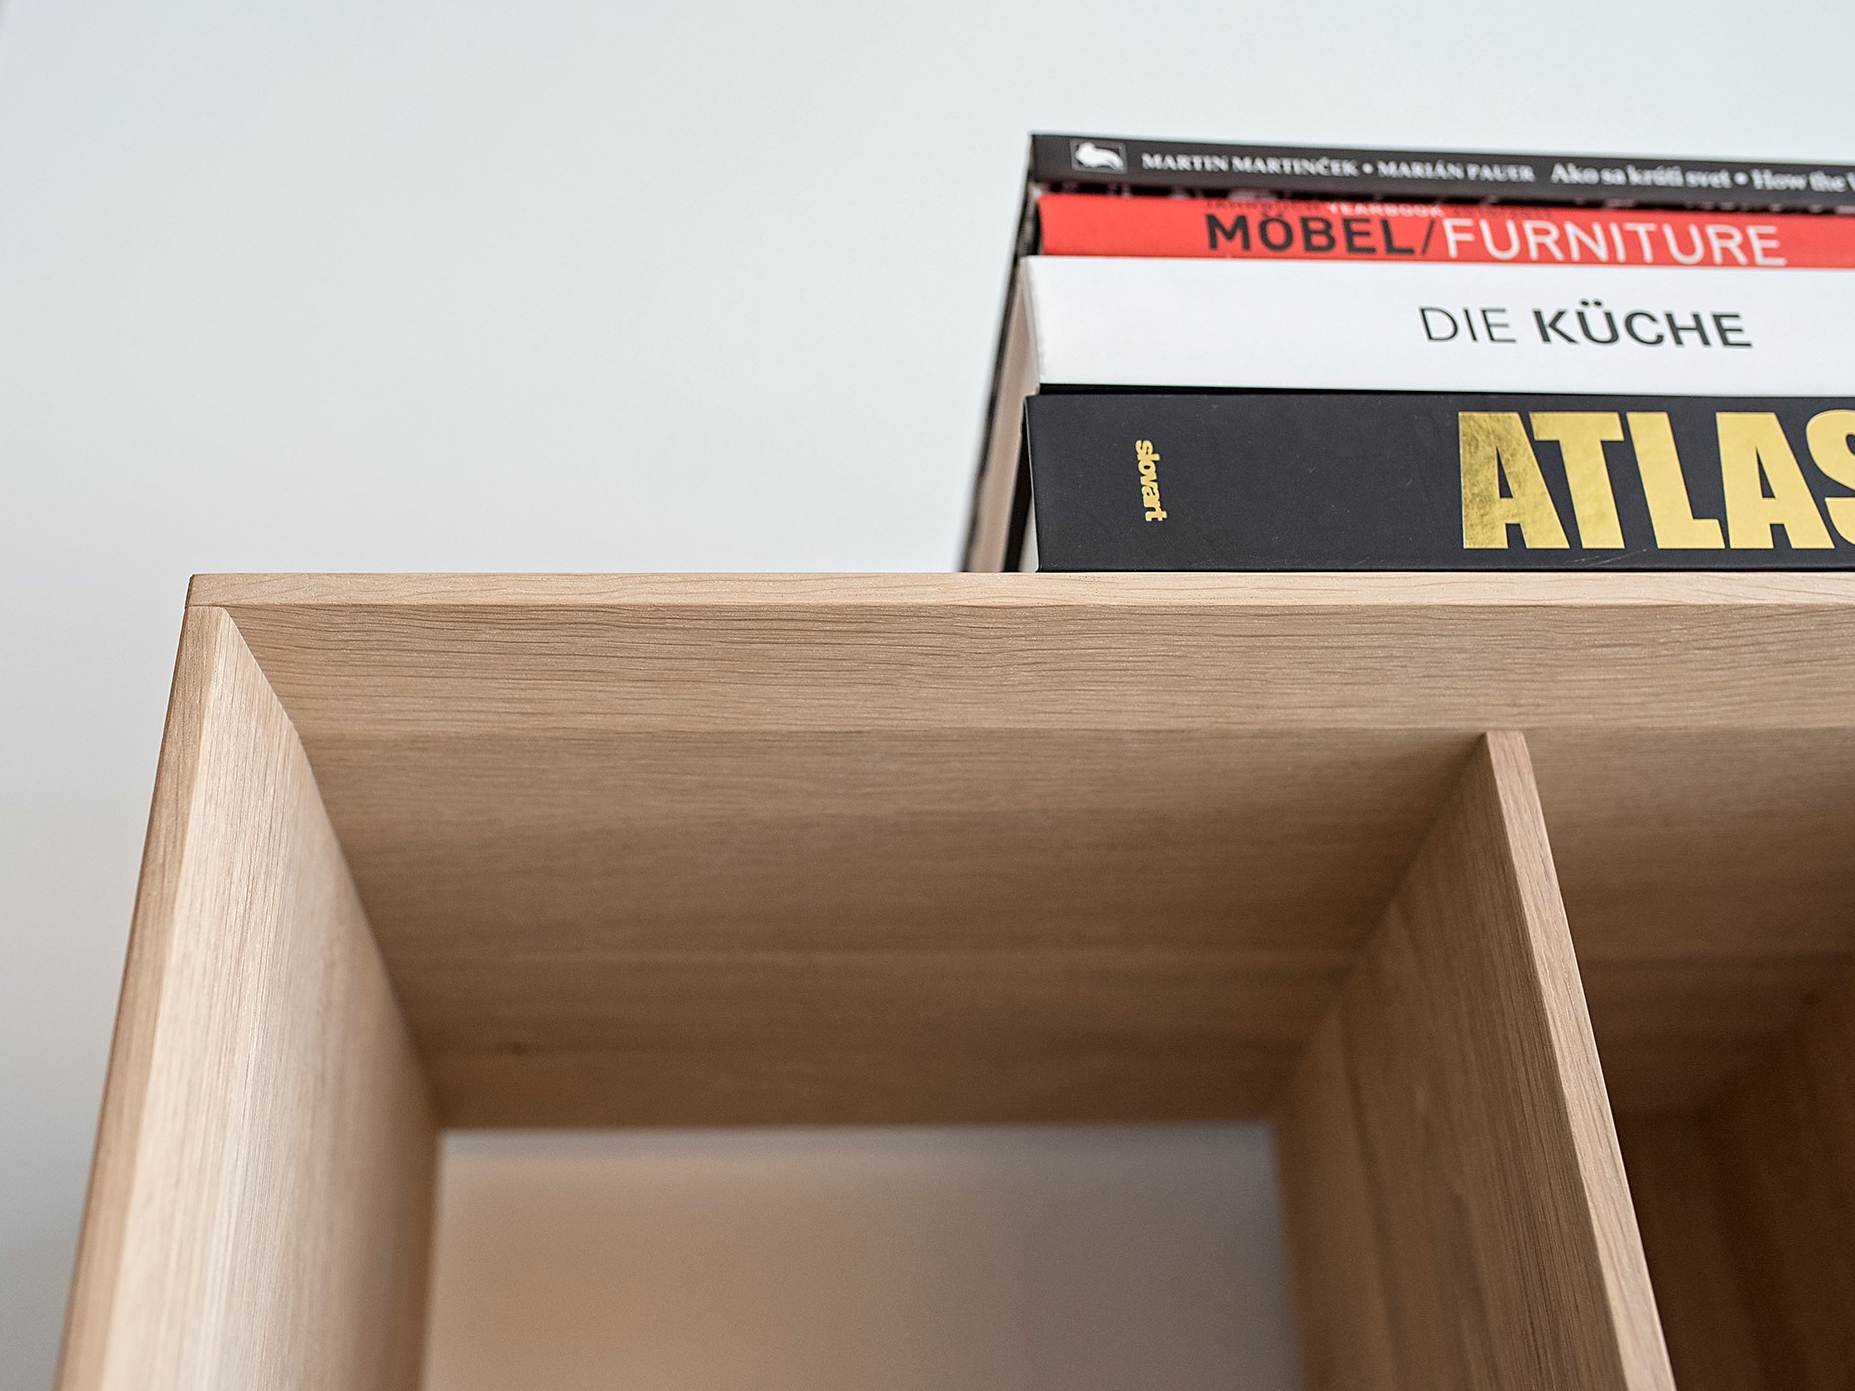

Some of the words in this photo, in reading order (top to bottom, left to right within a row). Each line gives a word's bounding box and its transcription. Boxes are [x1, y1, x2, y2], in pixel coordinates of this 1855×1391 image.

[1141, 153, 1230, 172] MARTIN
[1231, 155, 1360, 177] MARTINČEK
[1551, 162, 1600, 185] Ako
[1751, 168, 1808, 191] How
[1808, 169, 1848, 193] the
[1420, 306, 1517, 344] DIE
[1532, 299, 1754, 348] KÜCHE
[1135, 439, 1168, 522] slovart
